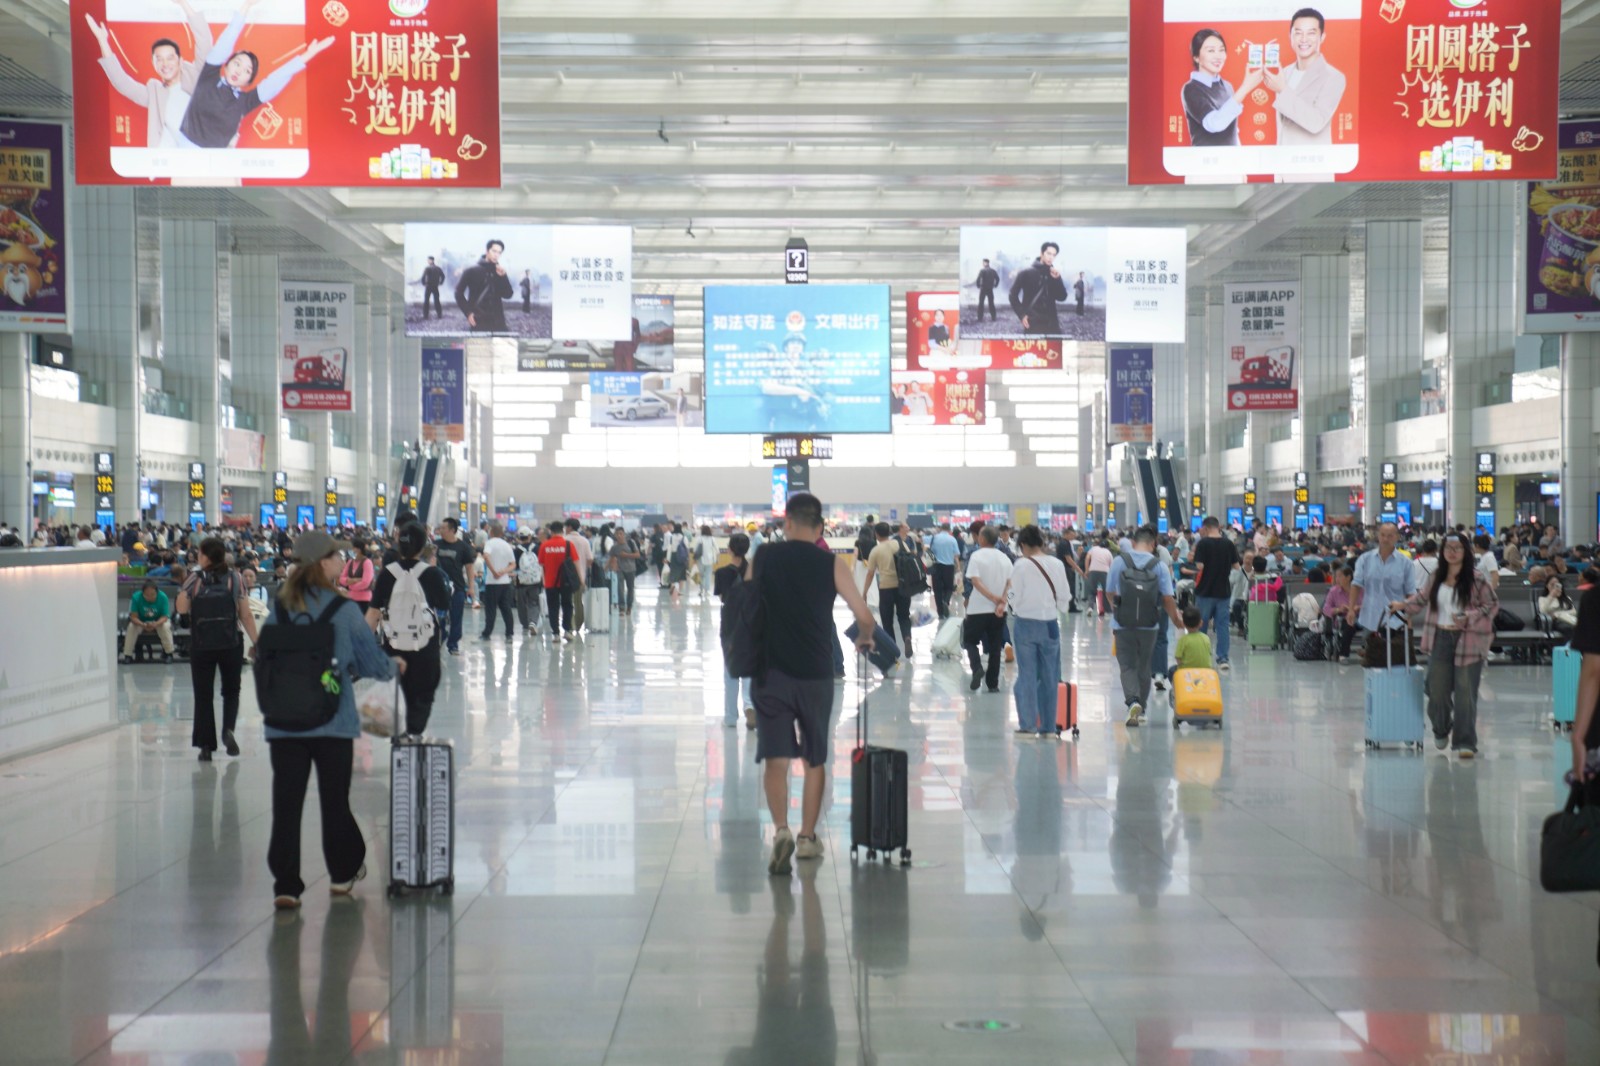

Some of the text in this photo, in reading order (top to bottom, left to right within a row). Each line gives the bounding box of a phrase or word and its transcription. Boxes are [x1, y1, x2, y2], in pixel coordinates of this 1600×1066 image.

[1406, 22, 1531, 74] 团圆搭子
[350, 31, 470, 81] 团圆搭子
[1416, 77, 1514, 128] 选伊利
[364, 86, 457, 136] 选伊利
[571, 256, 614, 269] 气温多变
[1125, 259, 1168, 272] 气温多变
[786, 273, 808, 283] 12306
[284, 289, 347, 303] 运满满APP
[1231, 290, 1295, 304] 运满满APP
[294, 306, 338, 318] 全国货运
[1241, 307, 1285, 318] 全国货运
[294, 319, 338, 331] 总量第一
[713, 314, 881, 331] 知法守法 文明出行
[1241, 320, 1285, 331] 总量第一
